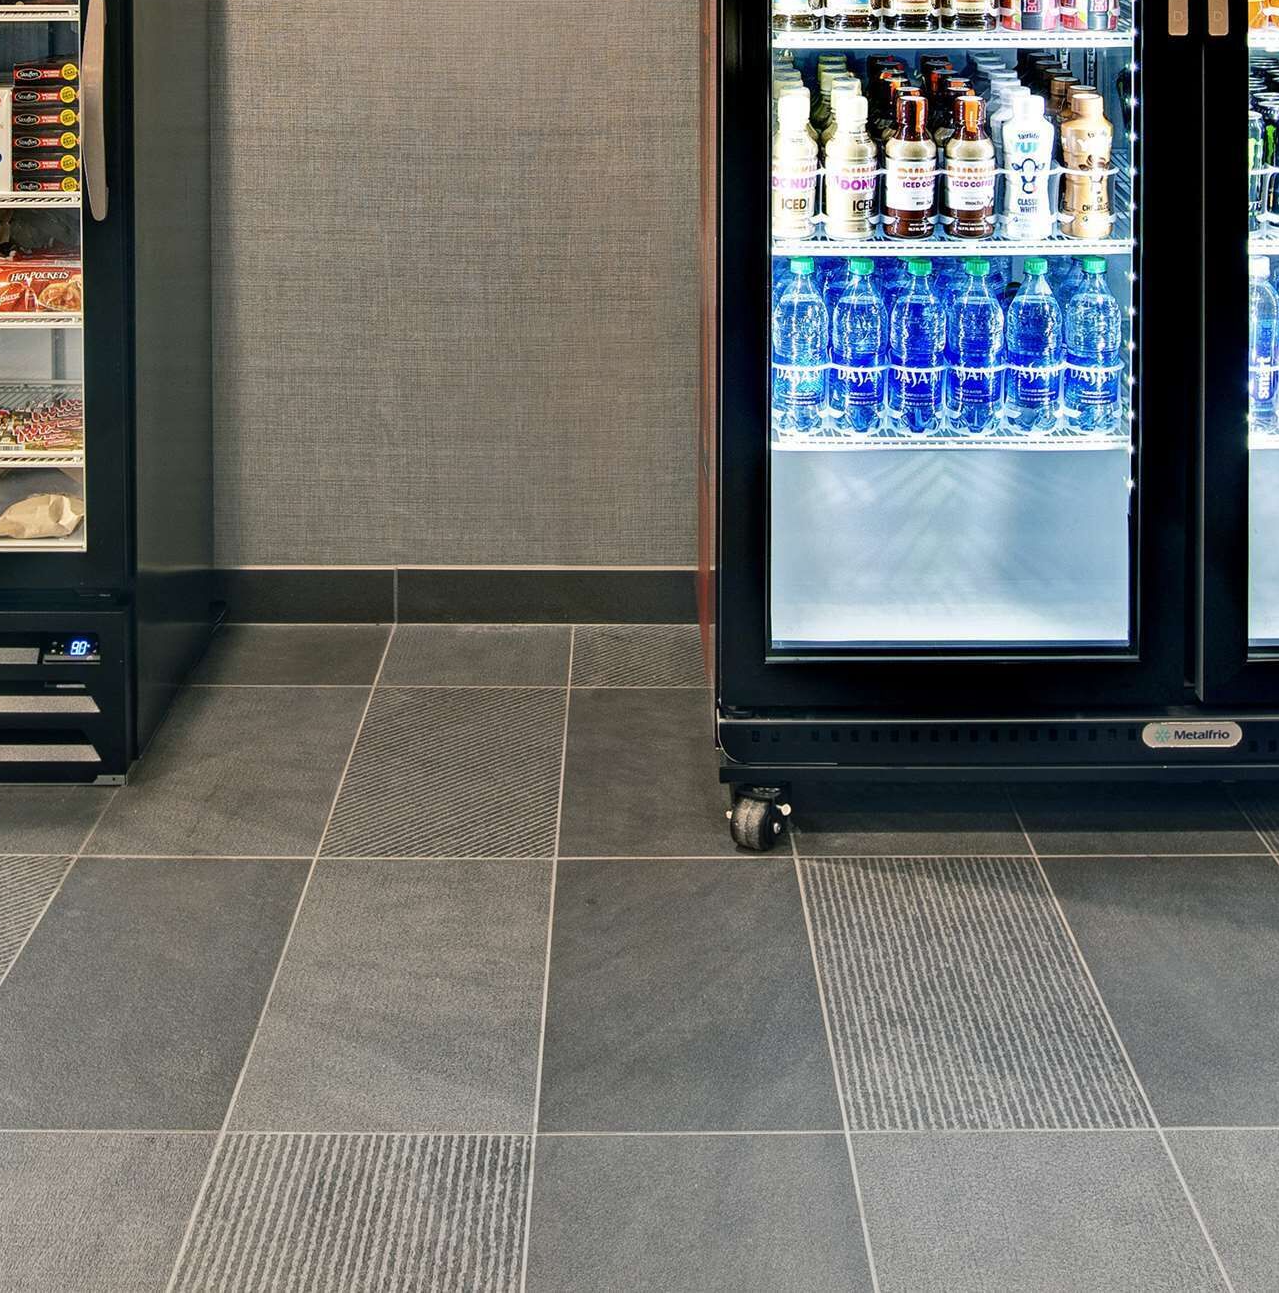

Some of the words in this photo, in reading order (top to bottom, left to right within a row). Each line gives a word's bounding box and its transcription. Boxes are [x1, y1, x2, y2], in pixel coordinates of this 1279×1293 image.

[903, 181, 921, 189] ICED
[10, 272, 29, 283] HOT
[30, 271, 71, 281] POCKETS
[1173, 729, 1230, 740] Metalfrio
